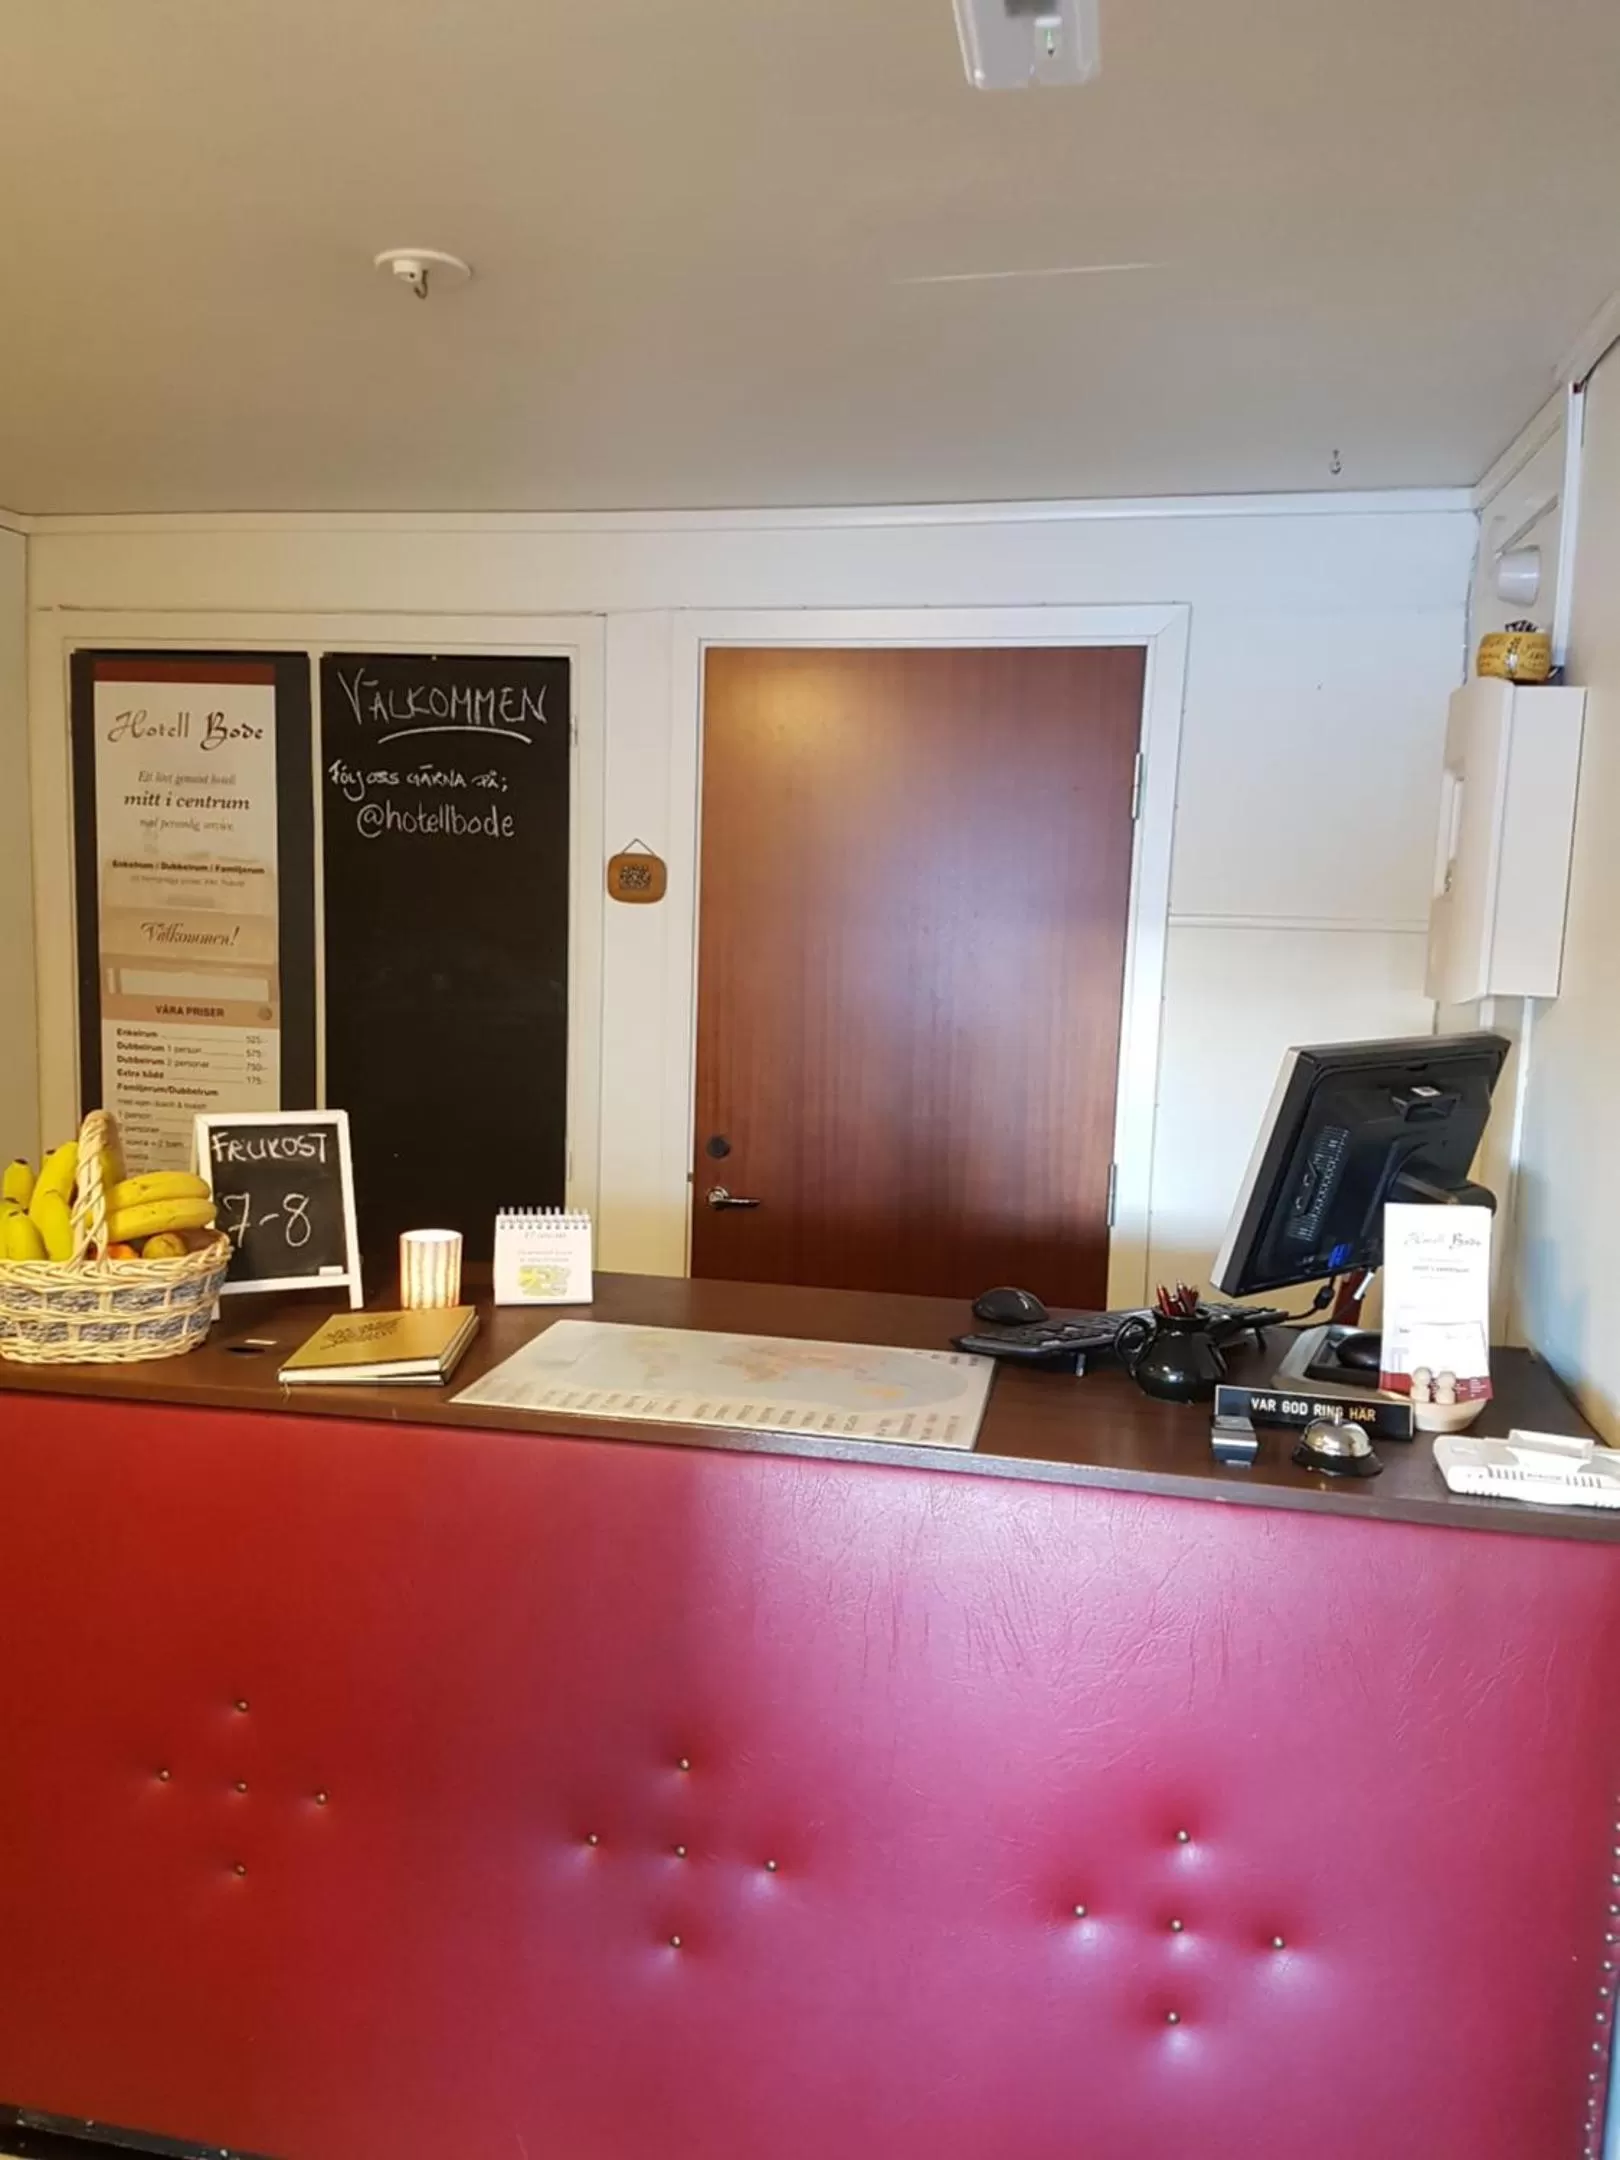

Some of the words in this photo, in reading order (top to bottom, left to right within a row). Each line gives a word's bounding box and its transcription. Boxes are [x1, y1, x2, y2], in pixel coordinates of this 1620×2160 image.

[337, 667, 548, 726] VÄLKOMMEN
[107, 709, 190, 742] Hotell
[200, 710, 264, 751] Bode
[124, 790, 161, 807] mitt
[166, 790, 173, 807] i
[176, 795, 251, 810] centrum
[356, 799, 516, 838] @hotellbode
[140, 921, 240, 947] Välkommen!
[155, 1003, 184, 1016] VÅRA
[186, 1005, 225, 1018] PRISER
[116, 1041, 165, 1052] Dubbelrum
[116, 1055, 165, 1066] Dubbelrum
[211, 1131, 328, 1163] FRUKOST
[1251, 1397, 1277, 1412] VAR
[1281, 1399, 1309, 1416] GOD
[1313, 1403, 1344, 1418] RING
[1349, 1405, 1376, 1422] HÄR
